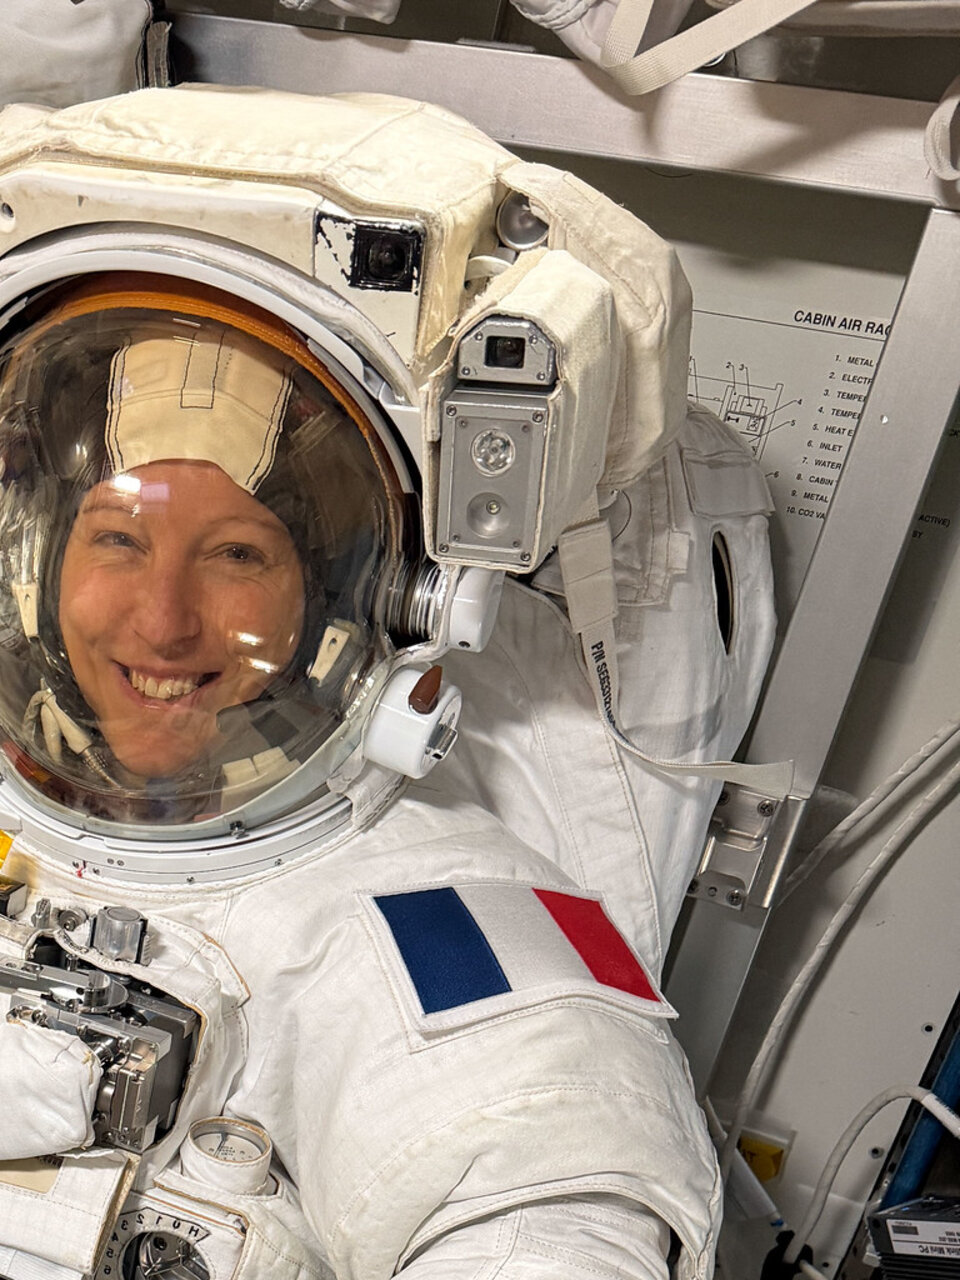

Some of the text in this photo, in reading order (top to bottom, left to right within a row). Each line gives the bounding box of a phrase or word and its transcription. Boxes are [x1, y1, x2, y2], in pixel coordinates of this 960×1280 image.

[794, 310, 837, 327] CABIN
[838, 317, 862, 332] AIR
[847, 356, 874, 367] METAL
[824, 425, 846, 435] HEAT
[819, 442, 843, 452] INLET
[814, 459, 842, 470] WATER
[809, 476, 834, 486] CABIN
[803, 491, 828, 503] METAL
[798, 508, 814, 518] CO2
[591, 641, 606, 663] P/N
[919, 1245, 929, 1253] PC
